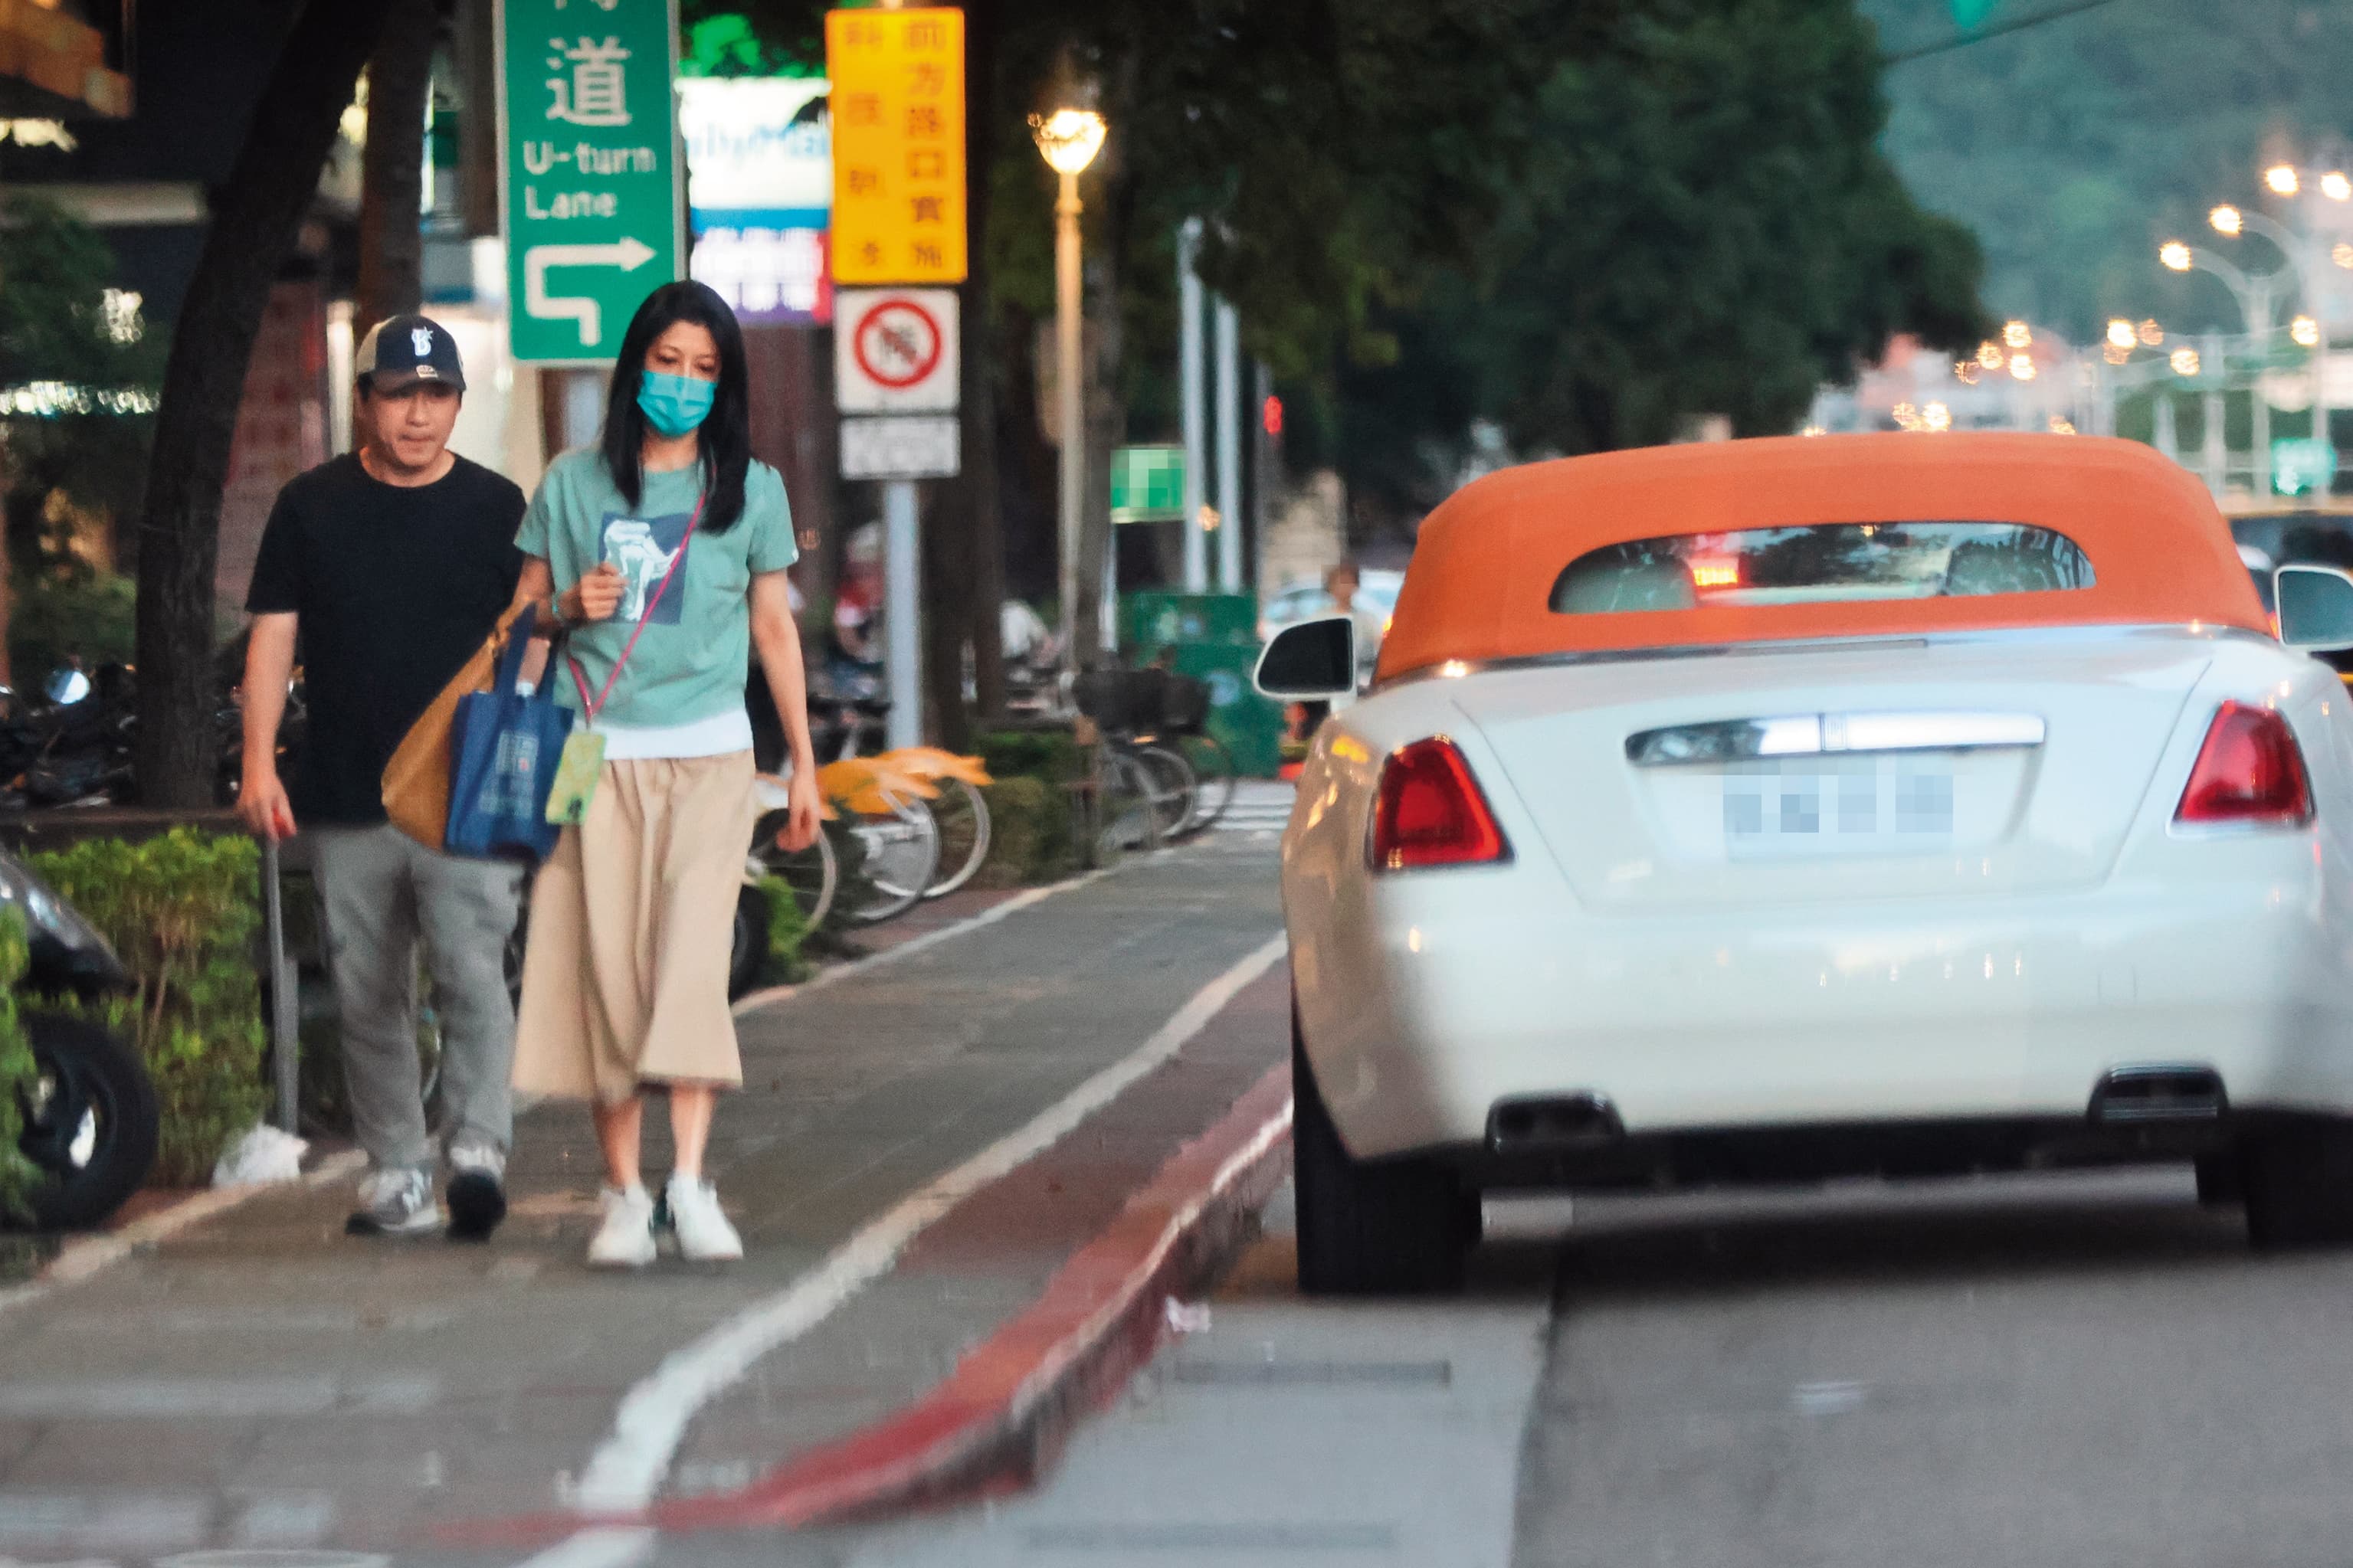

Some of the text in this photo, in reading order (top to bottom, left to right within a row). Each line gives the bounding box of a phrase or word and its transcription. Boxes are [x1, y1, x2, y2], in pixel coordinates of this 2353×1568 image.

[545, 0, 633, 127] 道
[523, 140, 657, 175] U-turn
[524, 185, 618, 220] Lane
